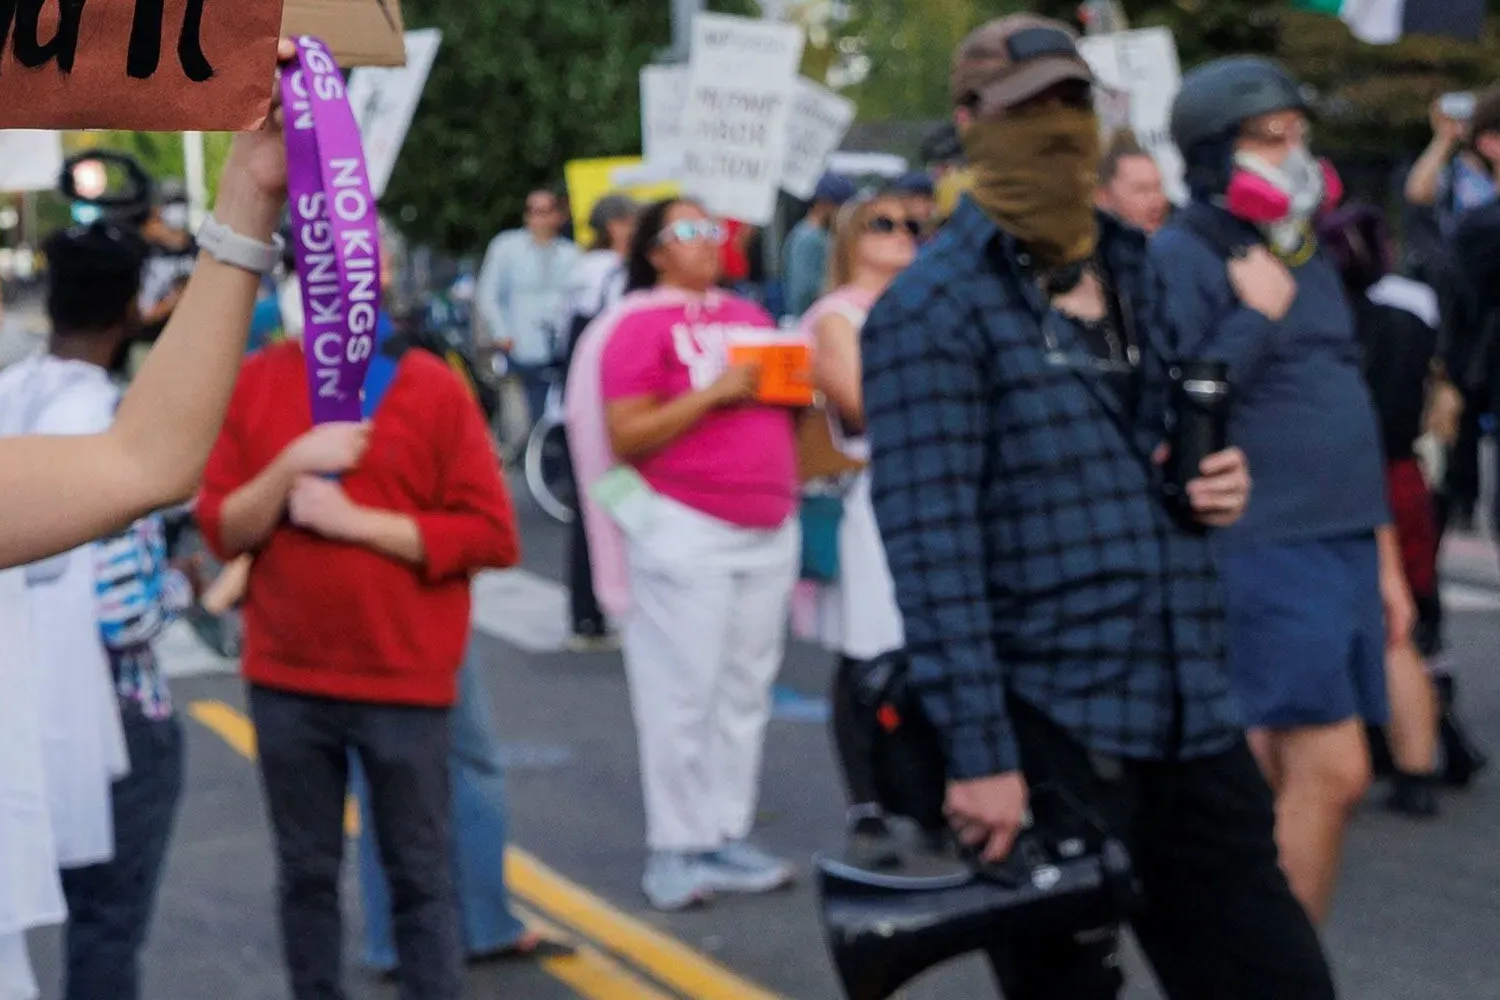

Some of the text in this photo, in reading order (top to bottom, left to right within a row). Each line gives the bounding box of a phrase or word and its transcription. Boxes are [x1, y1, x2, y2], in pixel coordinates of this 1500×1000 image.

[298, 191, 345, 400] NO KINGS
[329, 157, 377, 364] NO KINGS
